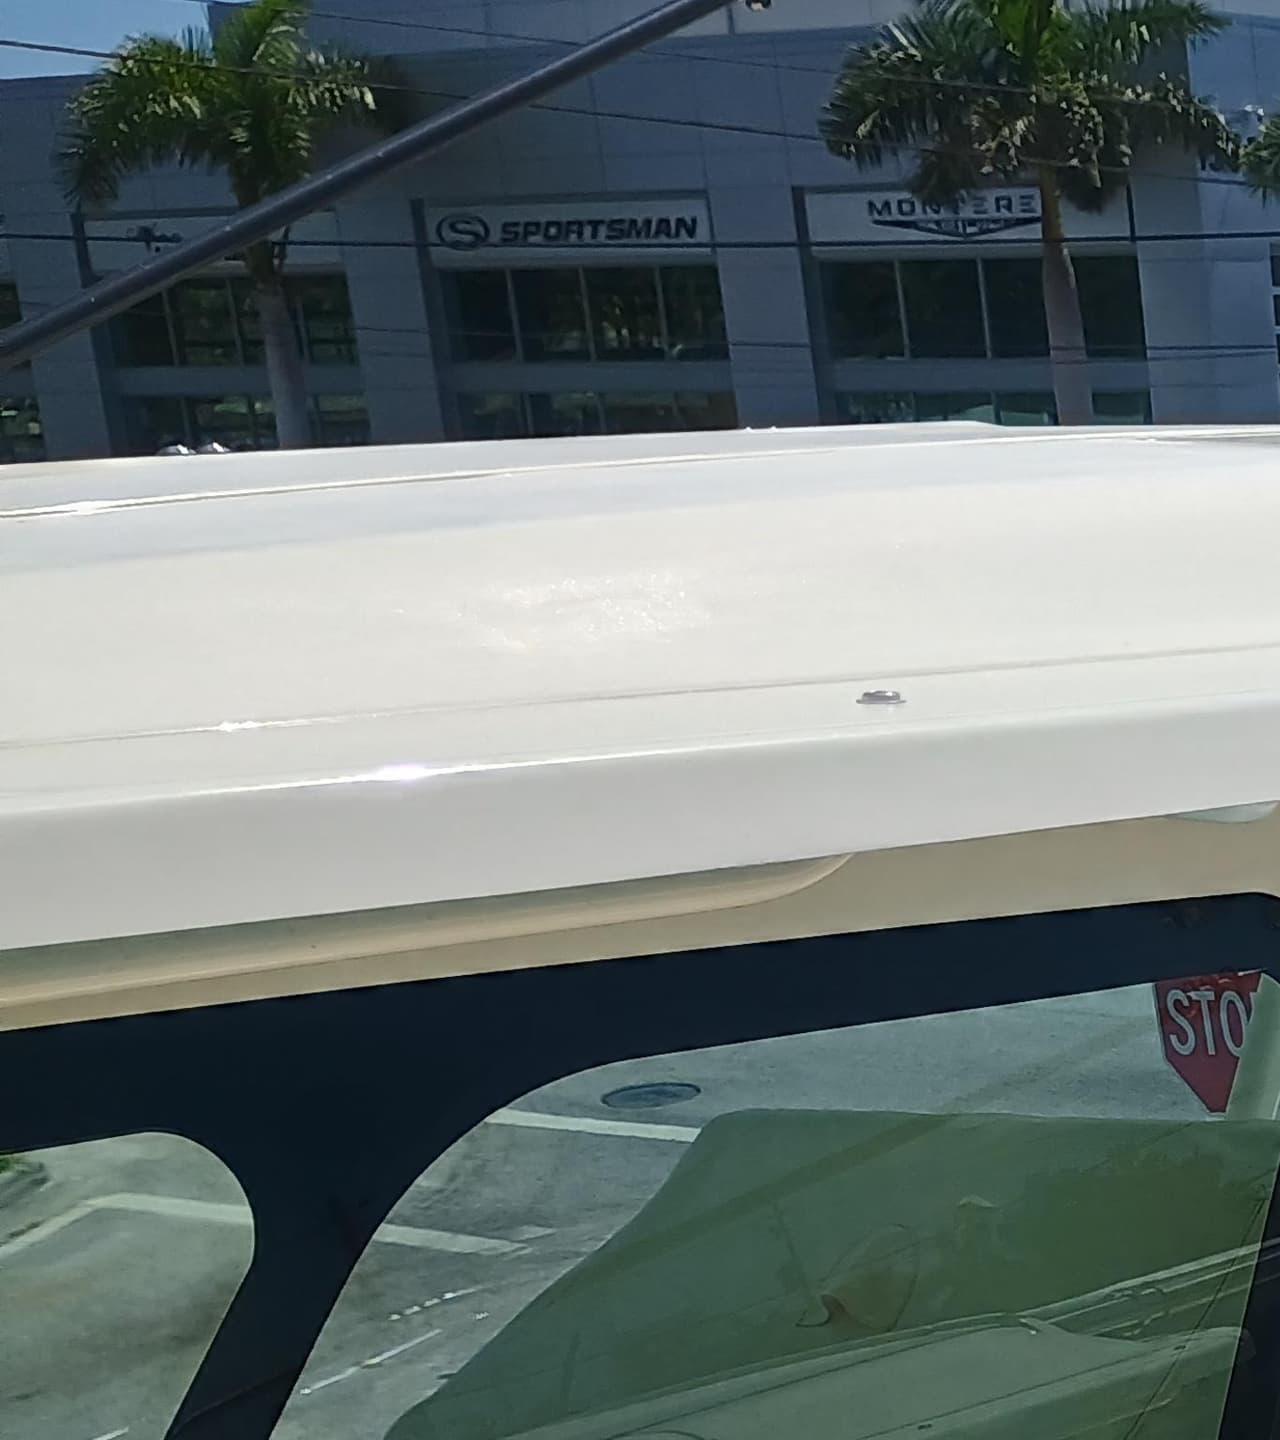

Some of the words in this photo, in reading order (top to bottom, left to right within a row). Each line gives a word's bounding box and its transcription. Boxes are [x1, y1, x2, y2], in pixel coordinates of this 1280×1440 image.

[867, 192, 1041, 217] MONERE
[501, 216, 697, 243] SPORTSMAN
[1166, 988, 1255, 1056] STO
